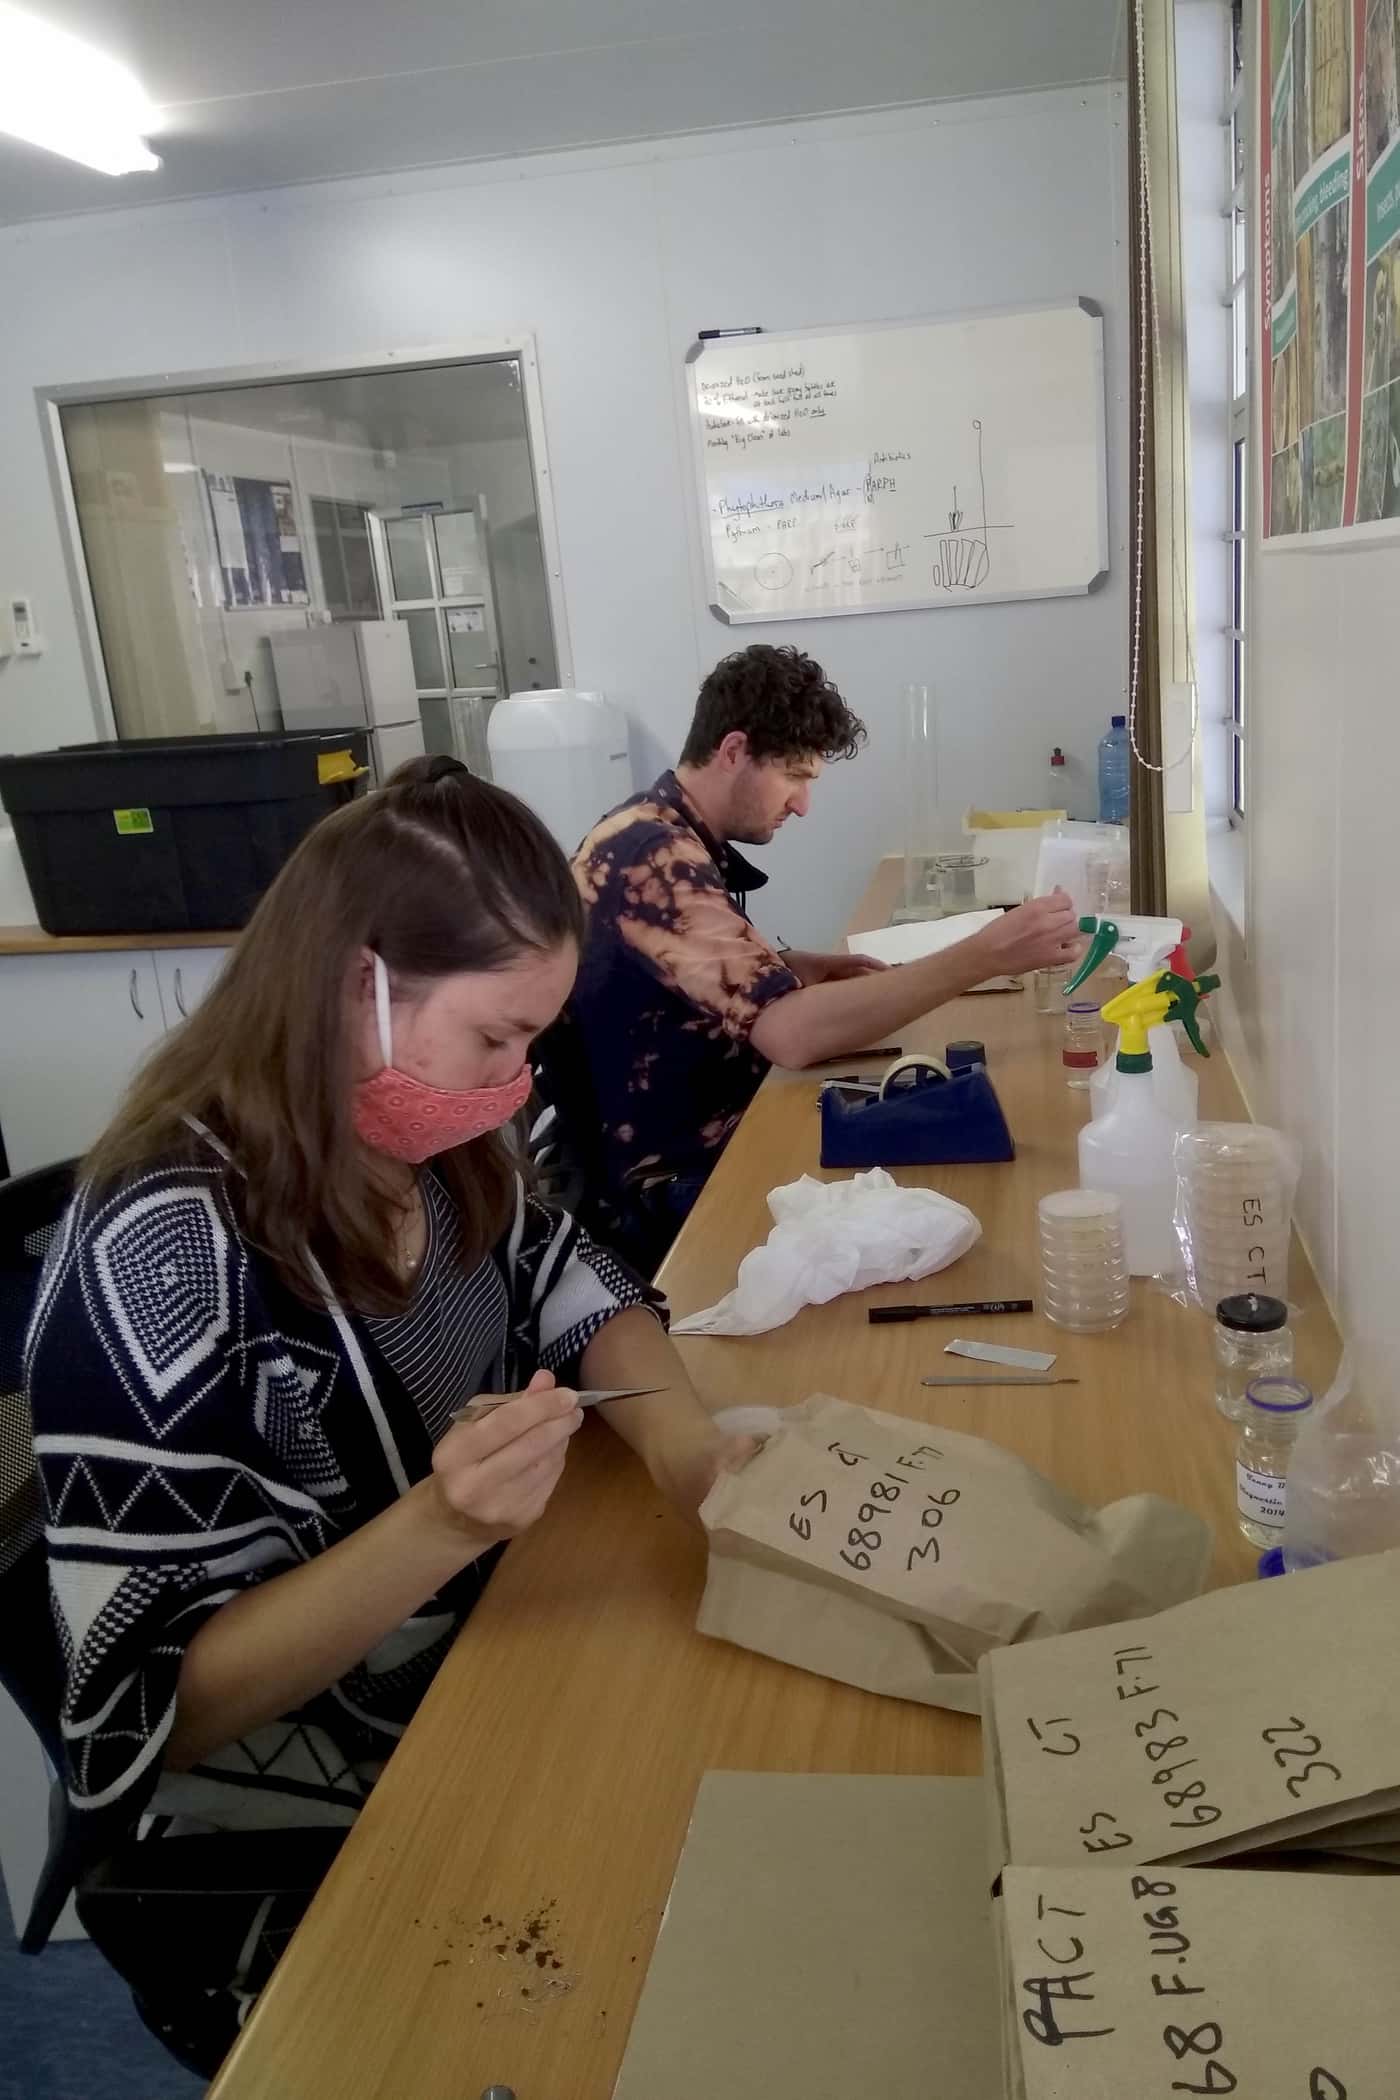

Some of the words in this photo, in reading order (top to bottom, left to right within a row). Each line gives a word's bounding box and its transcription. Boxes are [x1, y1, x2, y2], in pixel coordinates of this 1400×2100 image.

[1355, 72, 1365, 179] Signs
[1262, 173, 1272, 332] Symptoms
[1242, 1199, 1264, 1226] ES
[1247, 1246, 1267, 1286] CT
[788, 1489, 828, 1541] ES
[839, 1472, 909, 1572] 68981
[906, 1488, 961, 1572] 306
[1026, 1717, 1081, 1756] CT
[1134, 1708, 1223, 1829] 68983
[1261, 1716, 1342, 1799] 322
[1079, 1811, 1134, 1854] ES
